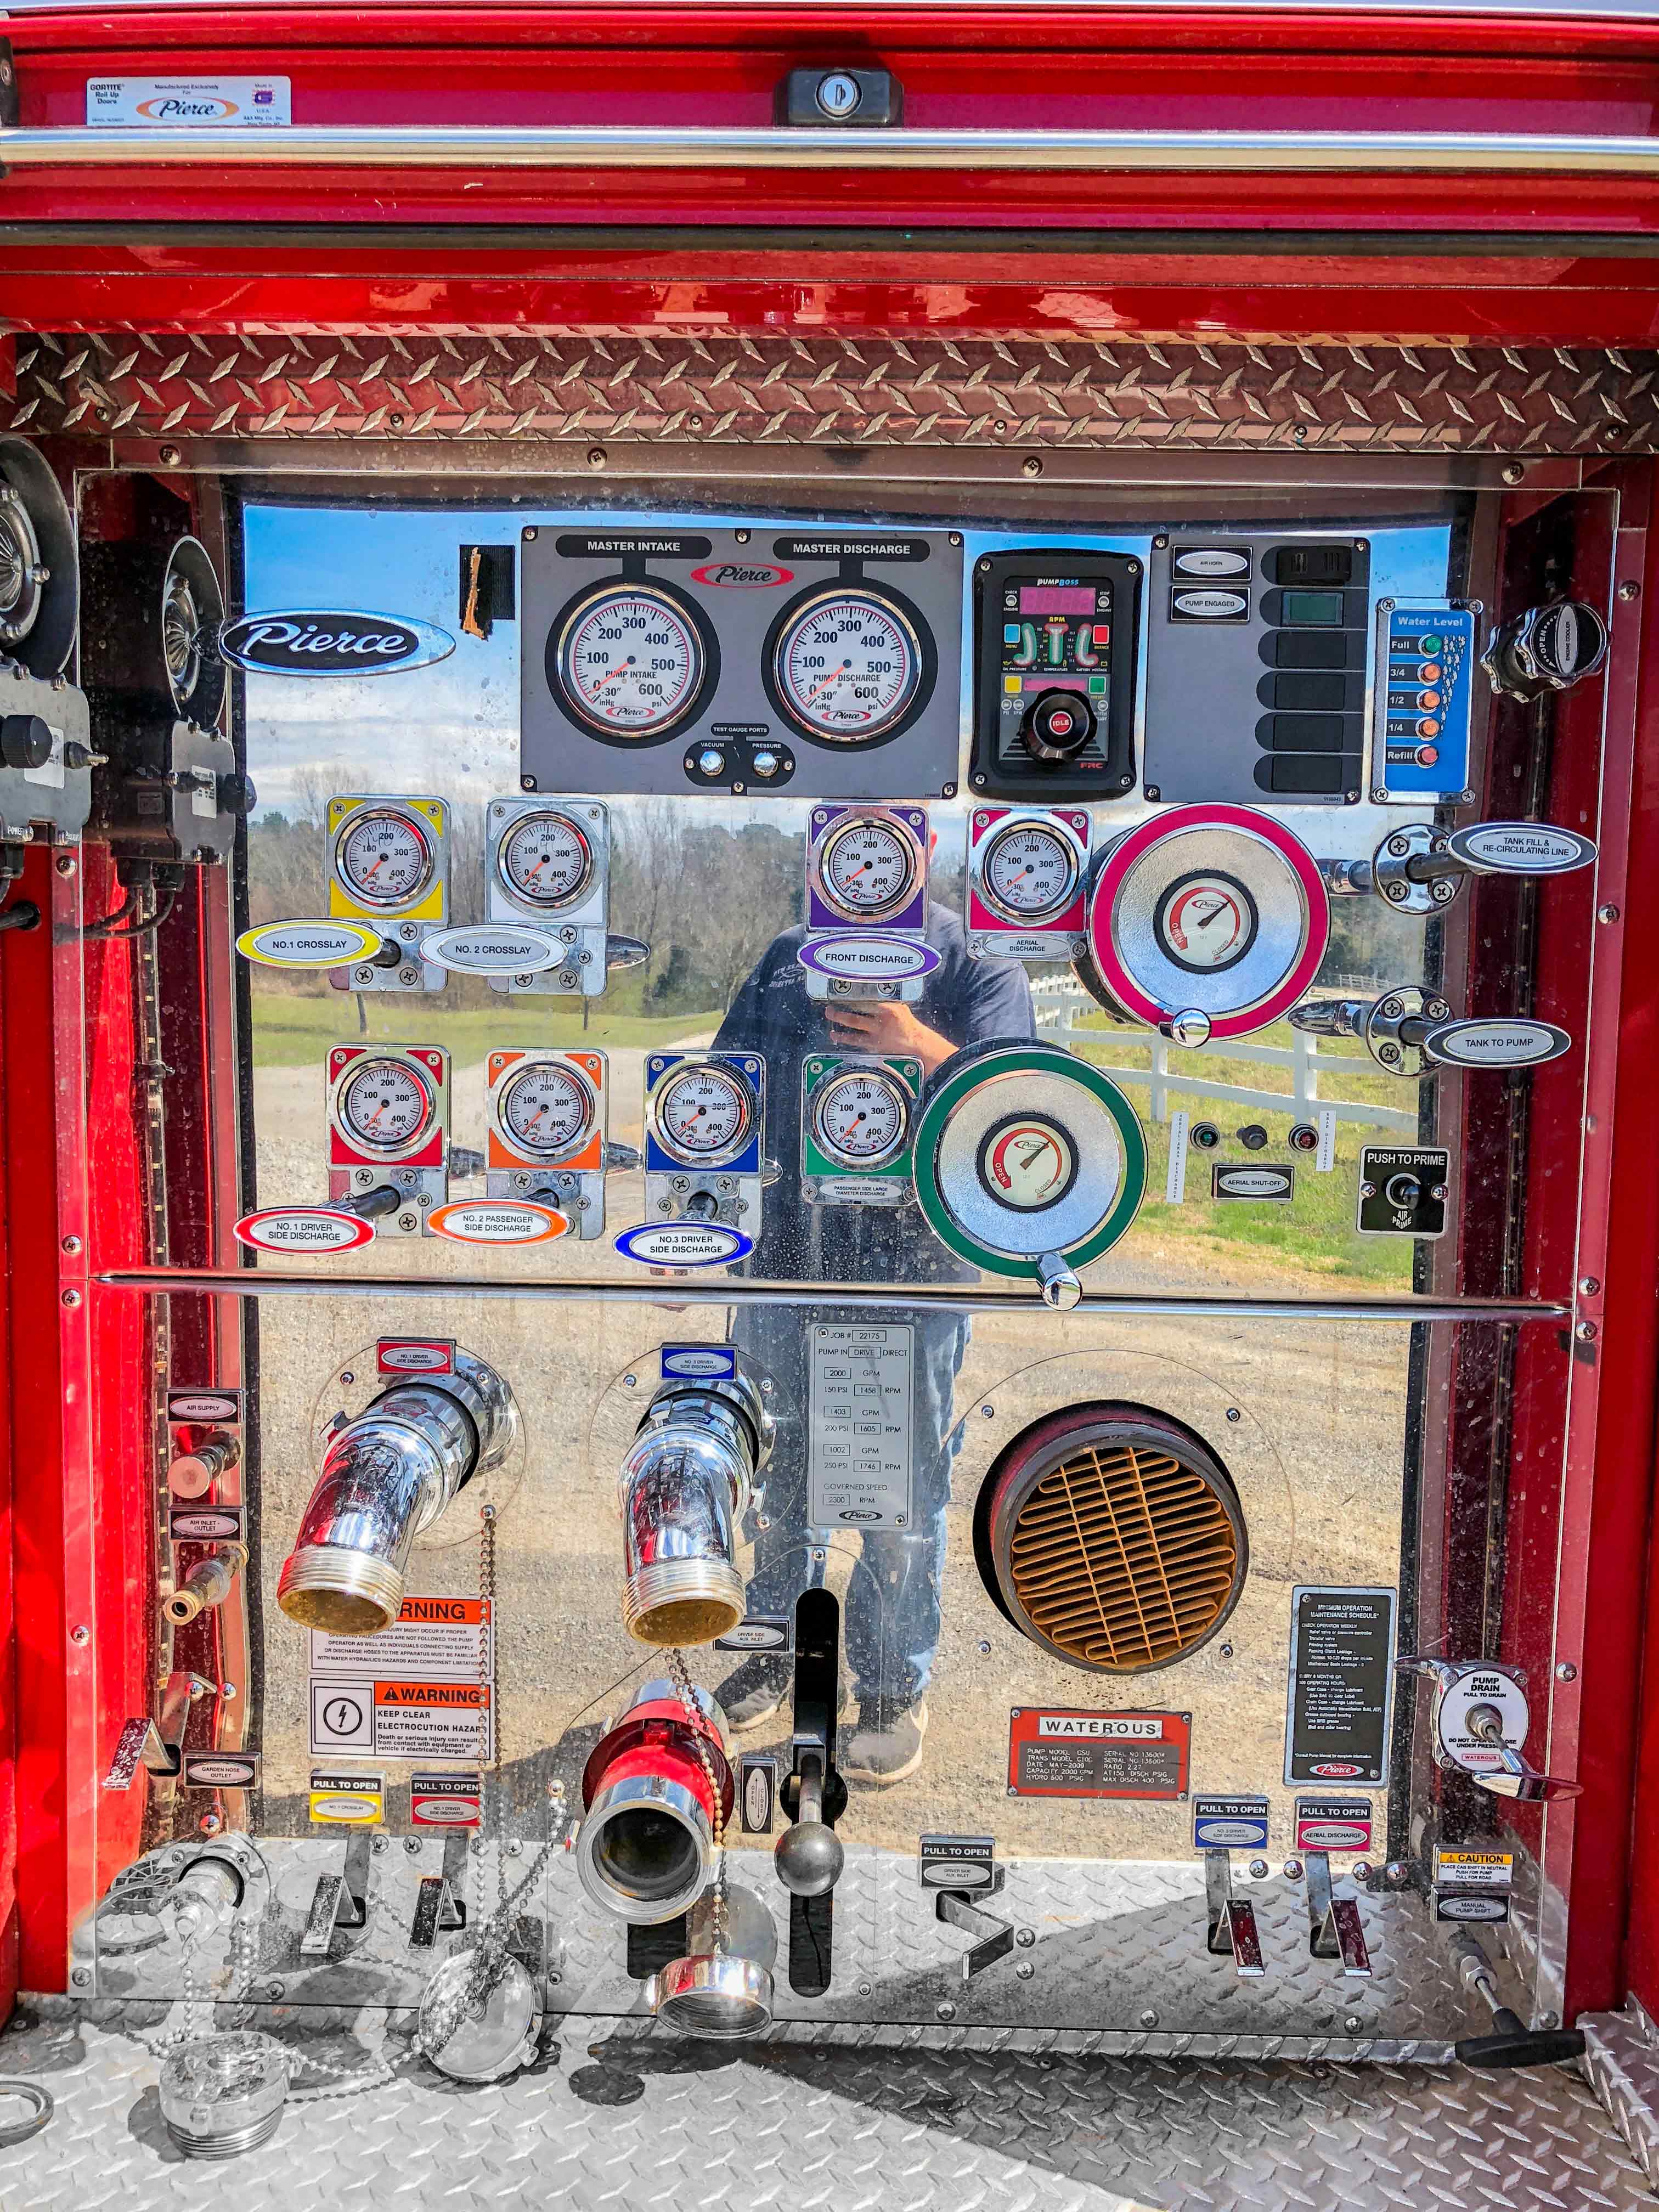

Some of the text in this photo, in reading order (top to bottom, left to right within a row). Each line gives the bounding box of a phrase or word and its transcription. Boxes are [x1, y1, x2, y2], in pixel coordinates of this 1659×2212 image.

[160, 99, 217, 117] Pierce
[588, 541, 680, 551] MASTER INTAKE
[793, 544, 910, 554] MASTER DISCHARGE
[715, 565, 772, 584] Pierce
[623, 617, 646, 629] 300
[838, 620, 861, 632] 300
[1398, 618, 1462, 627] Water Level
[237, 622, 407, 656] Pierce
[598, 628, 622, 640] 200
[645, 634, 669, 645] 400
[814, 632, 838, 644] 200
[861, 636, 885, 647] 400
[1391, 641, 1409, 649] Full
[587, 652, 609, 663] 100
[651, 659, 675, 670] 500
[838, 674, 881, 682] DISCHARGE
[639, 684, 662, 695] 600
[854, 686, 879, 698] 600
[617, 707, 644, 716] Pierce
[1387, 751, 1413, 760] Refill
[1483, 844, 1549, 855] RE-CIRCULATING
[1172, 923, 1184, 944] OPEN
[273, 940, 347, 949] NO.1 CROSSLAY
[455, 945, 531, 955] NO. 2 CROSSLAY
[860, 955, 913, 963] DISCHARGE
[1367, 1153, 1445, 1165] PUSH TO PRIME
[463, 1214, 533, 1223] NO. 2 PASSENGER
[1397, 1211, 1407, 1221] AIR
[276, 1223, 291, 1231] NO.
[300, 1223, 332, 1232] DRIVER
[483, 1223, 531, 1232] DISCHARGE
[1392, 1216, 1412, 1229] PRIME
[268, 1231, 340, 1241] SIDE DISCHARGE
[401, 1689, 480, 1703] WARNING
[378, 1723, 449, 1731] ELECTROCUTION
[1046, 1721, 1156, 1735] WATEROUS
